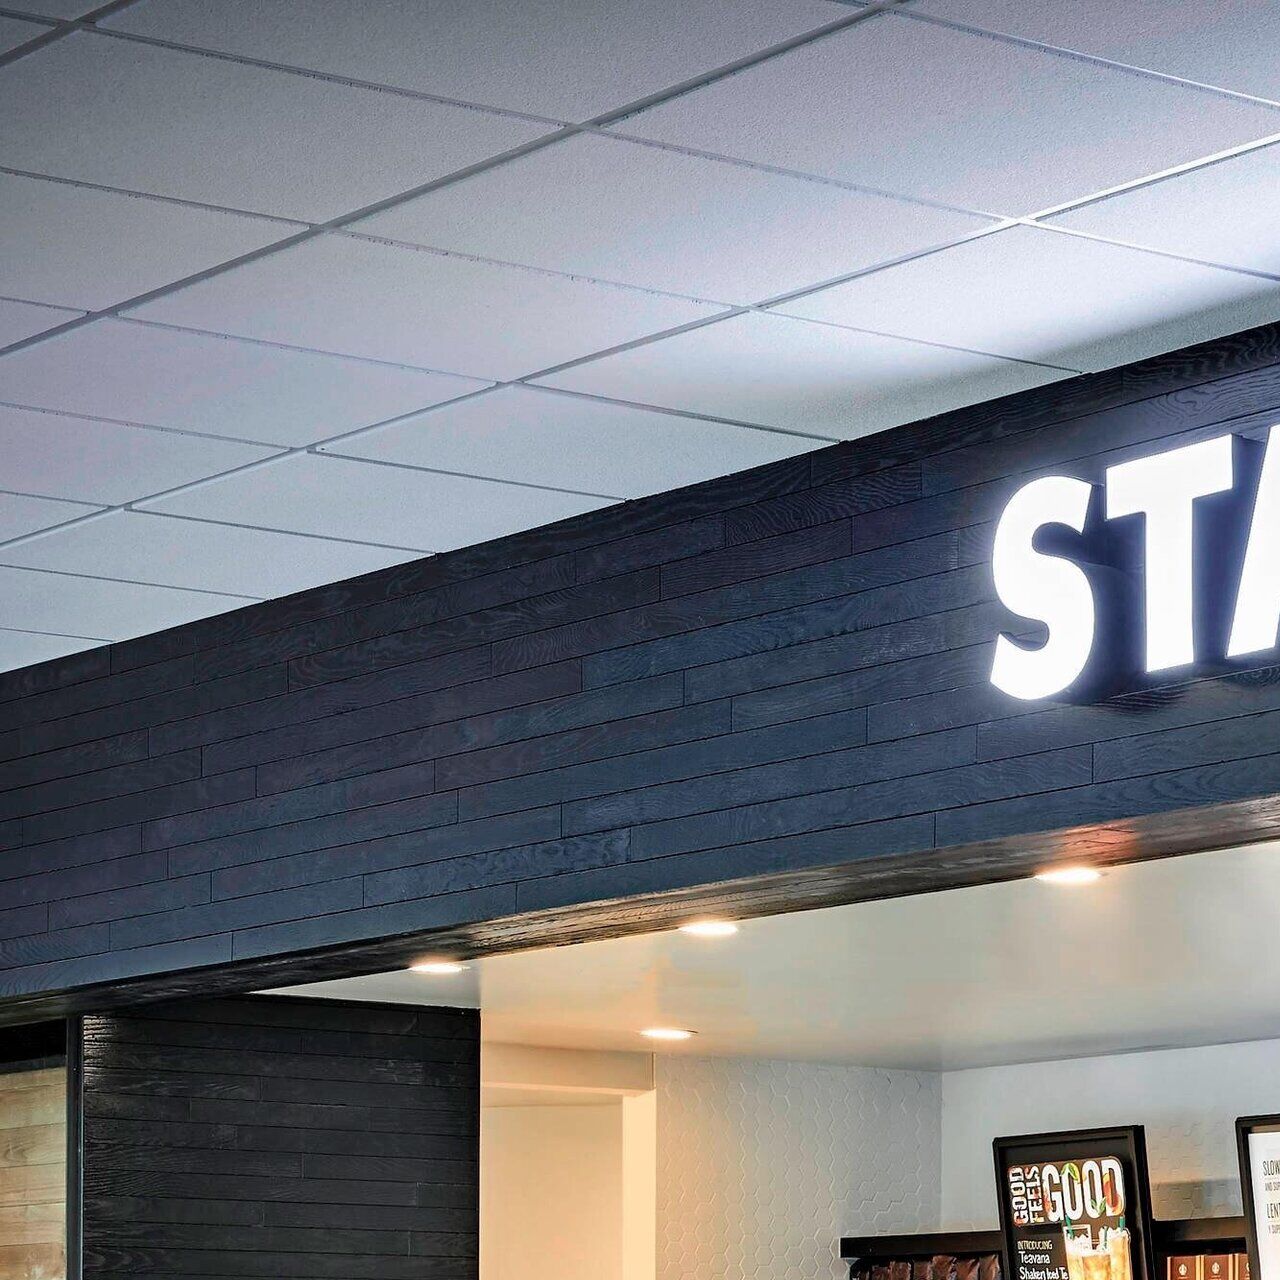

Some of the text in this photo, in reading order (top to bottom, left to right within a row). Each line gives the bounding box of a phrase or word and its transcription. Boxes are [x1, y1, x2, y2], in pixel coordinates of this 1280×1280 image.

[1010, 1167, 1029, 1226] GOOD
[1024, 1165, 1044, 1223] FEELS
[1042, 1159, 1124, 1222] GOOD
[1018, 1240, 1052, 1250] INTRODUCING
[1018, 1251, 1050, 1264] Teavana
[1020, 1266, 1046, 1280] Shaken
[1046, 1266, 1058, 1280] Iced
